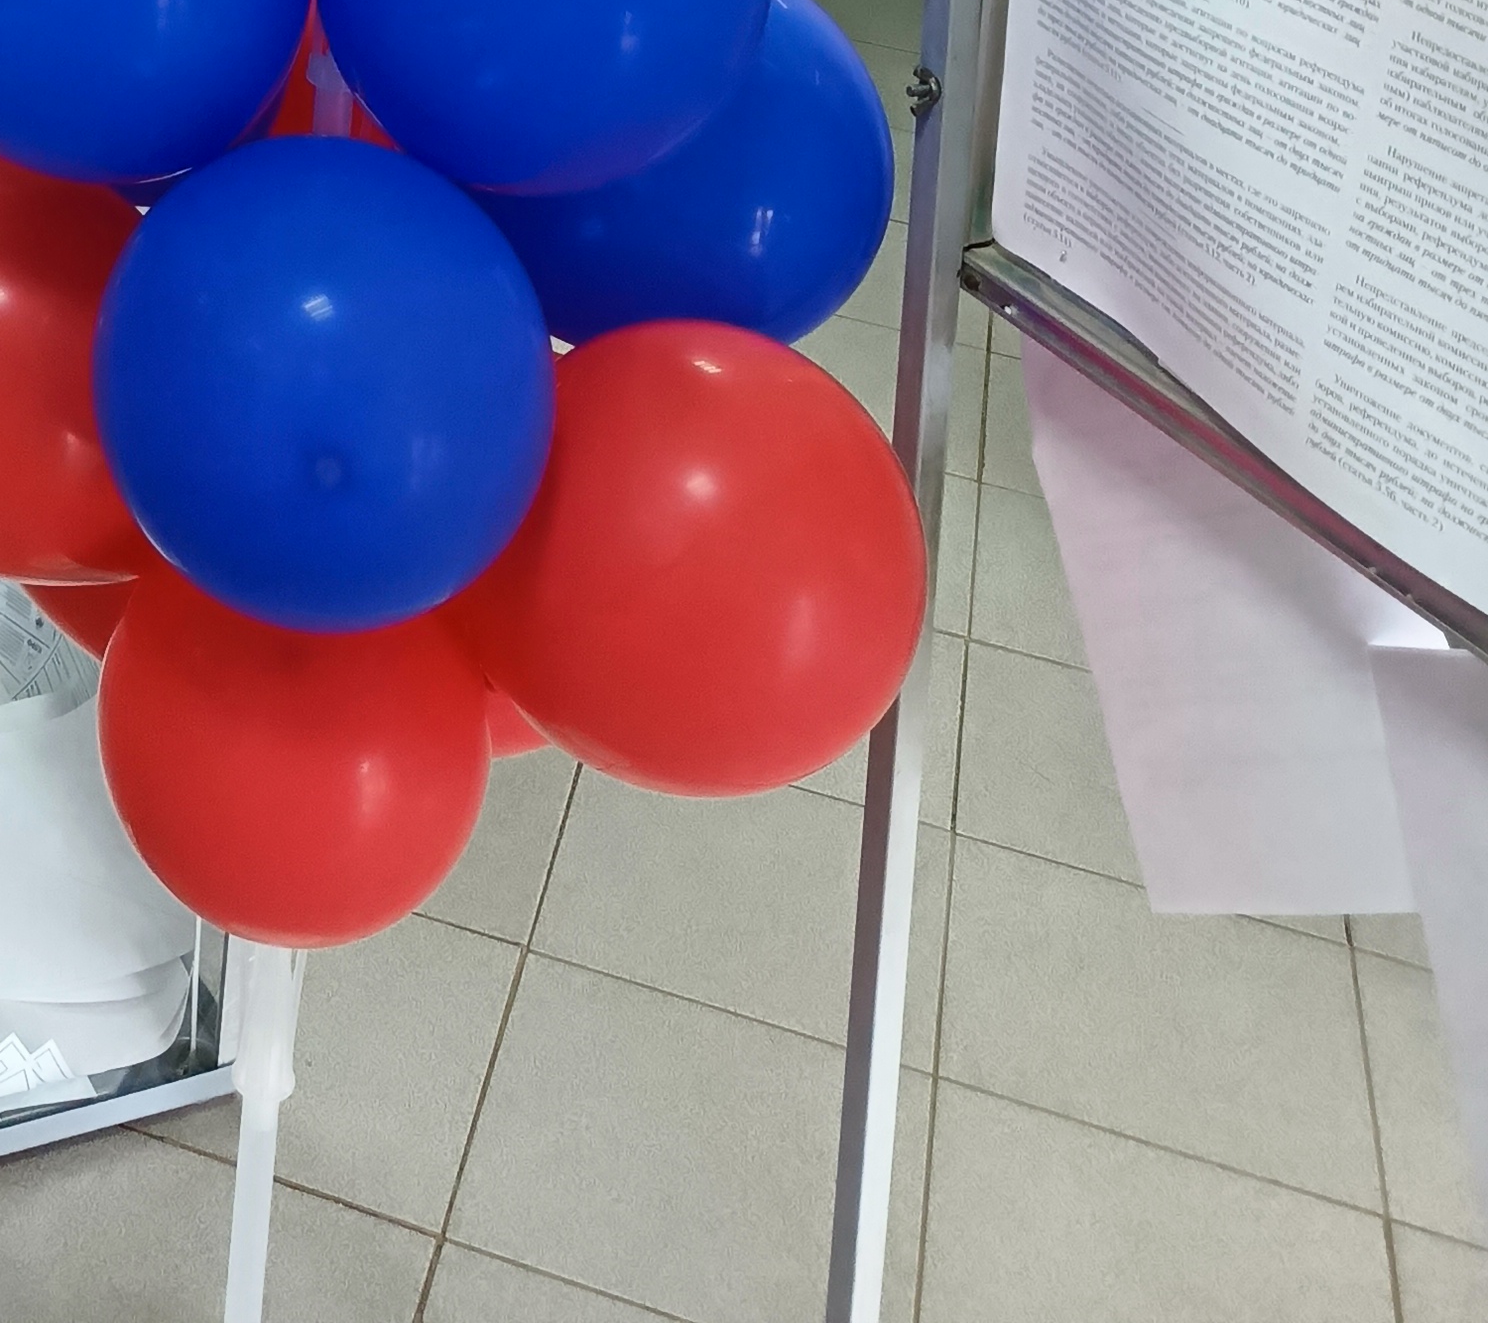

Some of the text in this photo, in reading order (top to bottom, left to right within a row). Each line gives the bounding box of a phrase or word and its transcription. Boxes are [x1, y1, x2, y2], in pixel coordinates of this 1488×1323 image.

[1387, 145, 1448, 184] Нарушение
[1403, 172, 1473, 215] референдума
[1333, 295, 1376, 325] тельную
[1355, 274, 1449, 333] Непредставление
[1356, 292, 1436, 344] избирательной
[1326, 324, 1459, 406] установленных законом
[1329, 309, 1349, 327] кой
[1357, 325, 1426, 371] проведением
[1334, 373, 1402, 424] Уничтожение
[1309, 408, 1410, 477] административного
[1312, 393, 1390, 448] установленного
[1391, 444, 1437, 478] порядка
